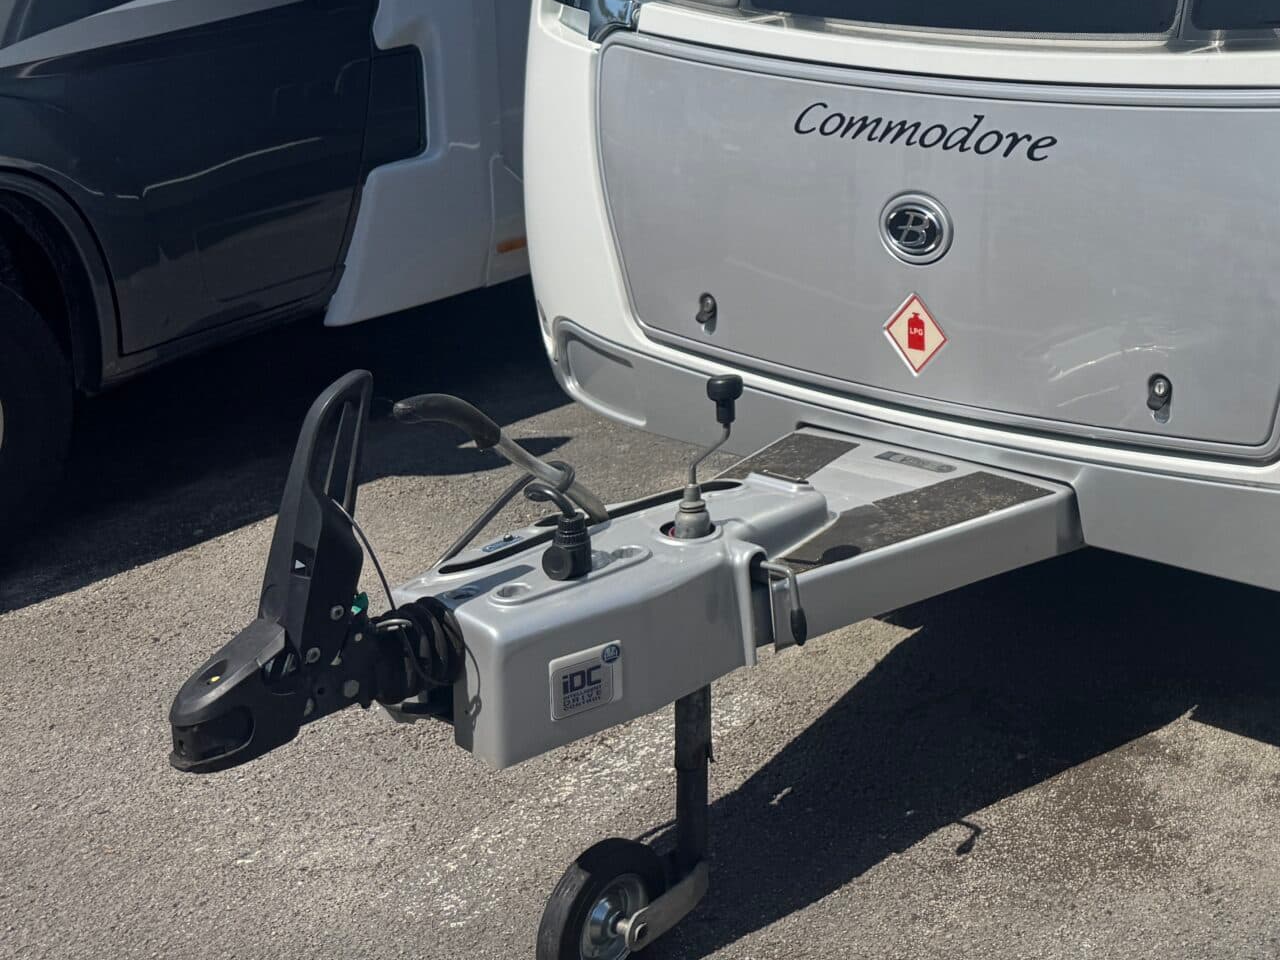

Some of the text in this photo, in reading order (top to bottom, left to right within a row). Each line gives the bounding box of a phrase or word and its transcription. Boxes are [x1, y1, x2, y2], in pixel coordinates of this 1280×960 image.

[793, 102, 1058, 162] Commodore
[896, 210, 930, 247] B
[909, 327, 924, 336] LPG
[562, 664, 602, 695] iDC
